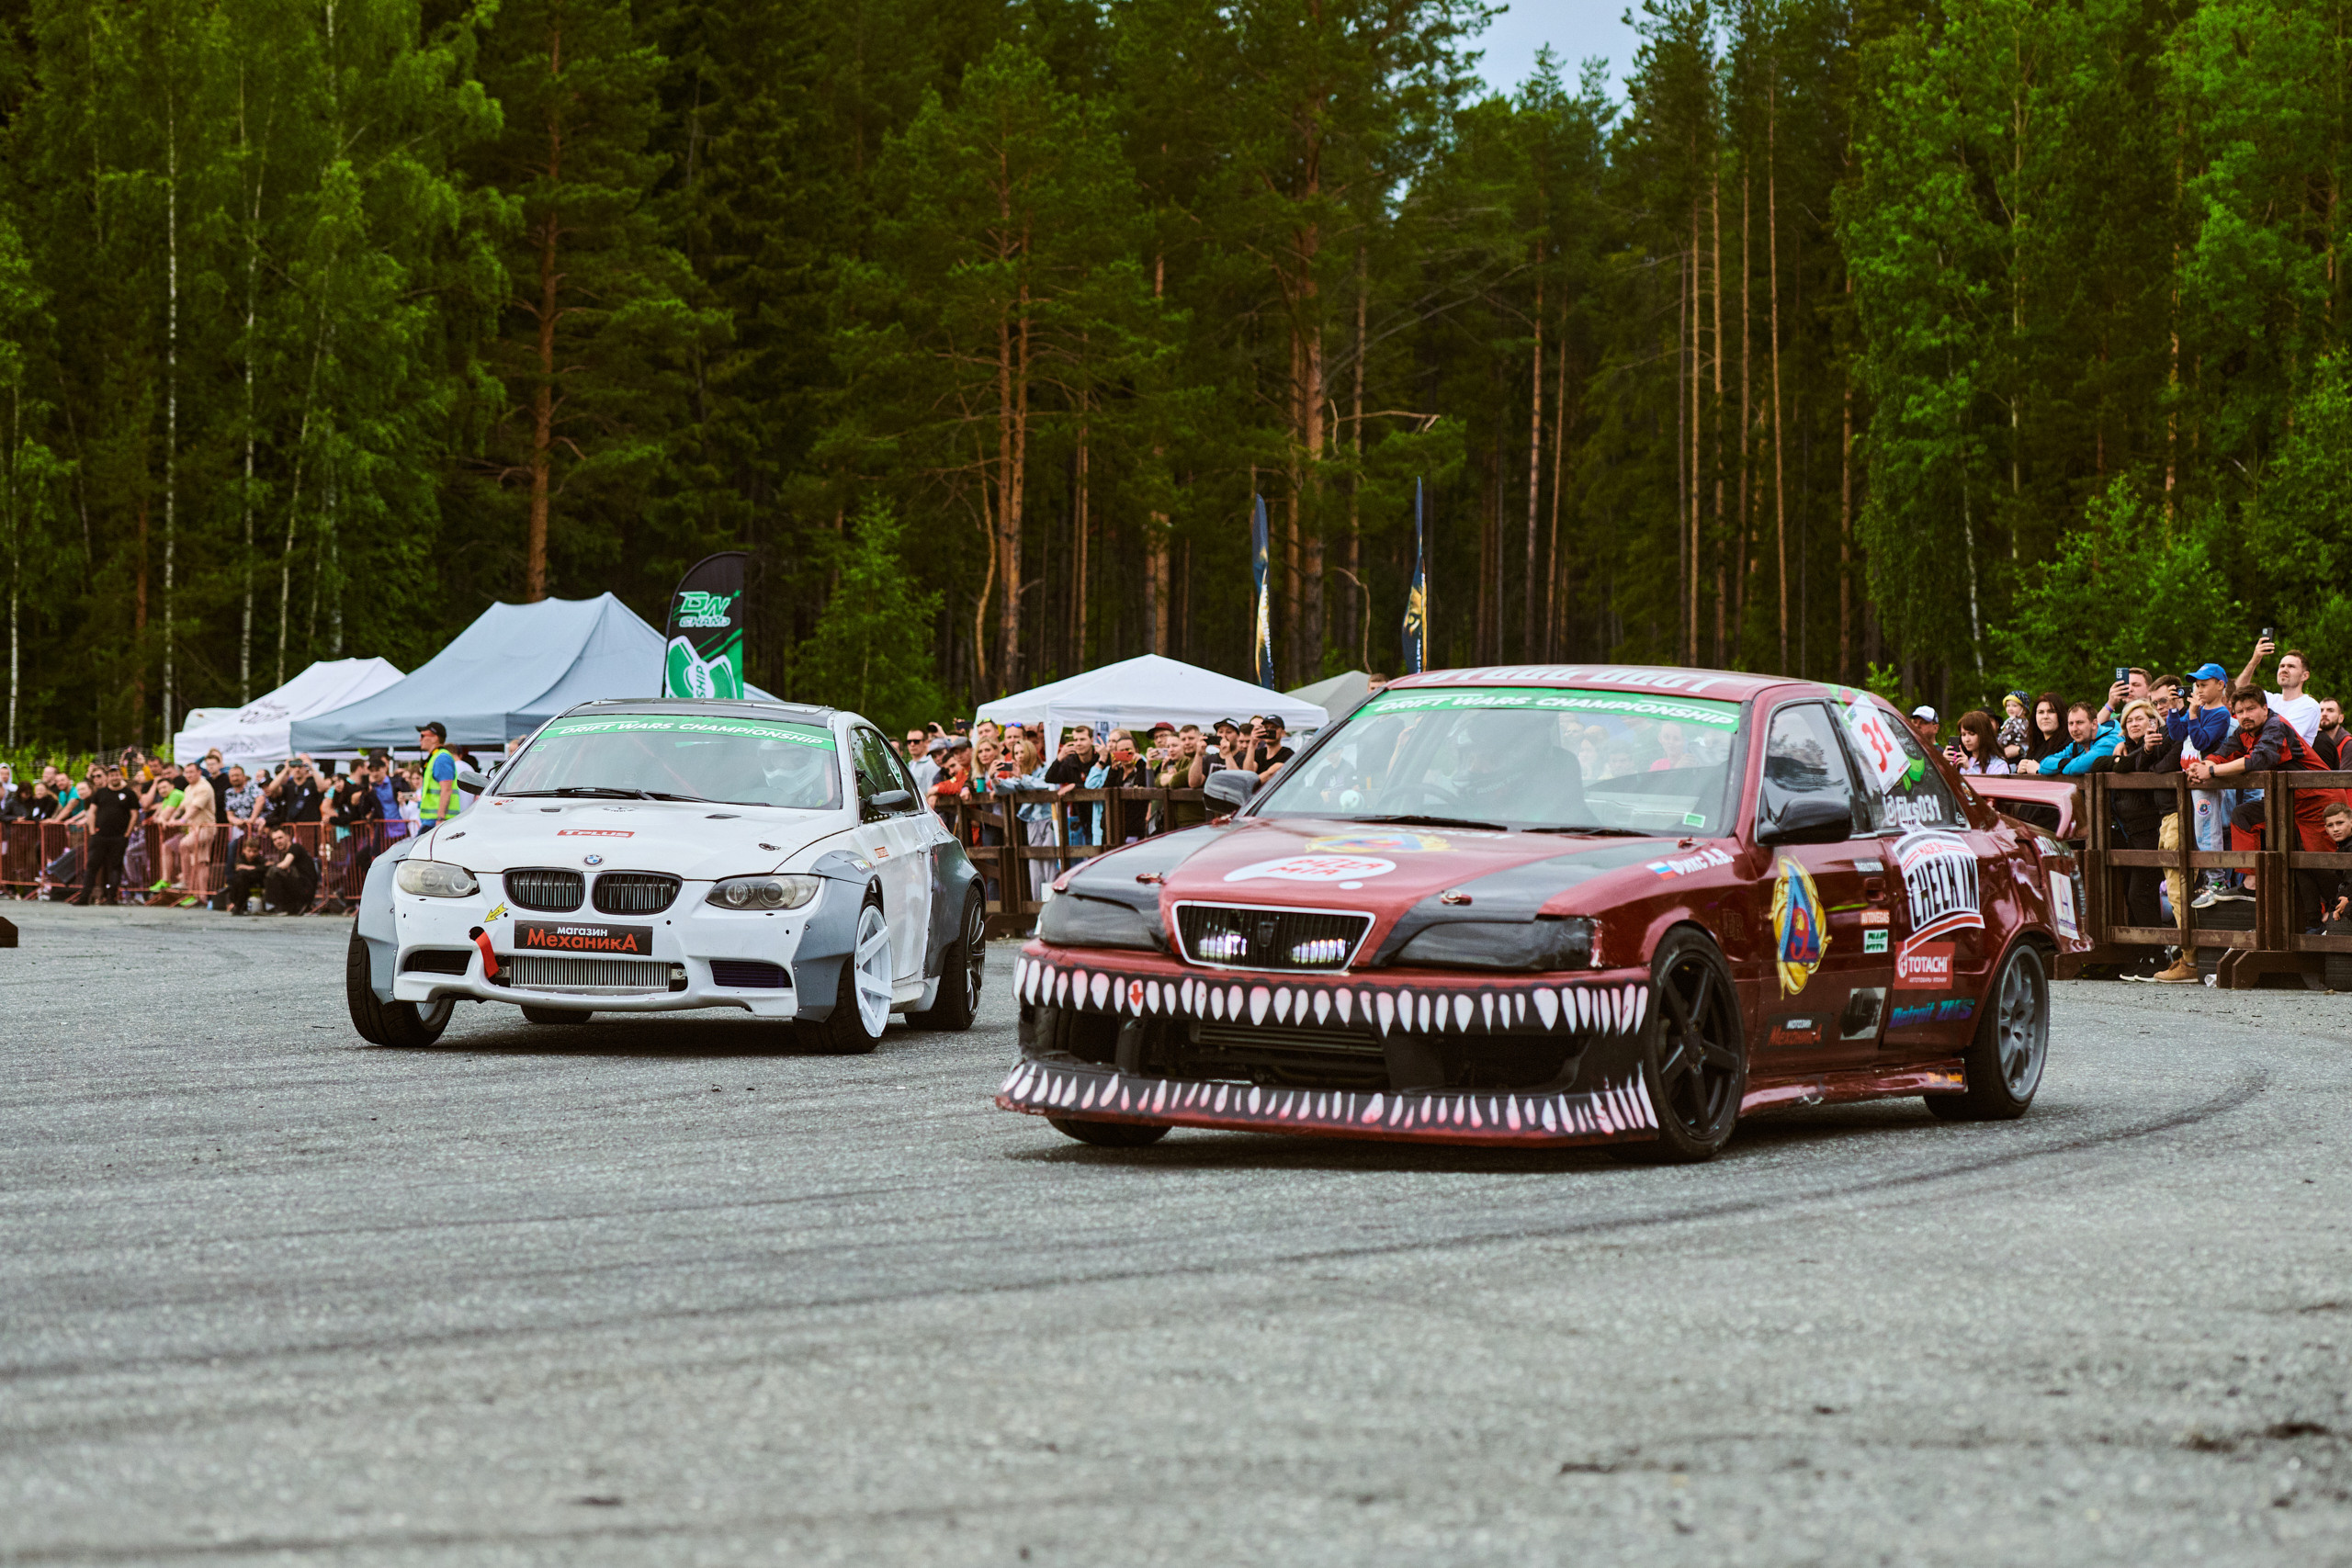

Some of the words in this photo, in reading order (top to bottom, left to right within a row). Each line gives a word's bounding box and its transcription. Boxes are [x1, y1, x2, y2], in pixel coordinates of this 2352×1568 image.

[1374, 697, 1449, 713] DRIFT
[1449, 696, 1534, 706] WARS
[1535, 697, 1736, 727] CHAMPIONSHIP
[558, 722, 617, 736] DRIFT
[616, 722, 675, 731] WARS
[677, 723, 825, 746] CHAMPIONSHIP
[1861, 716, 1894, 773] 31
[557, 926, 608, 937] магазин
[1908, 956, 1948, 973] TOTACHI
